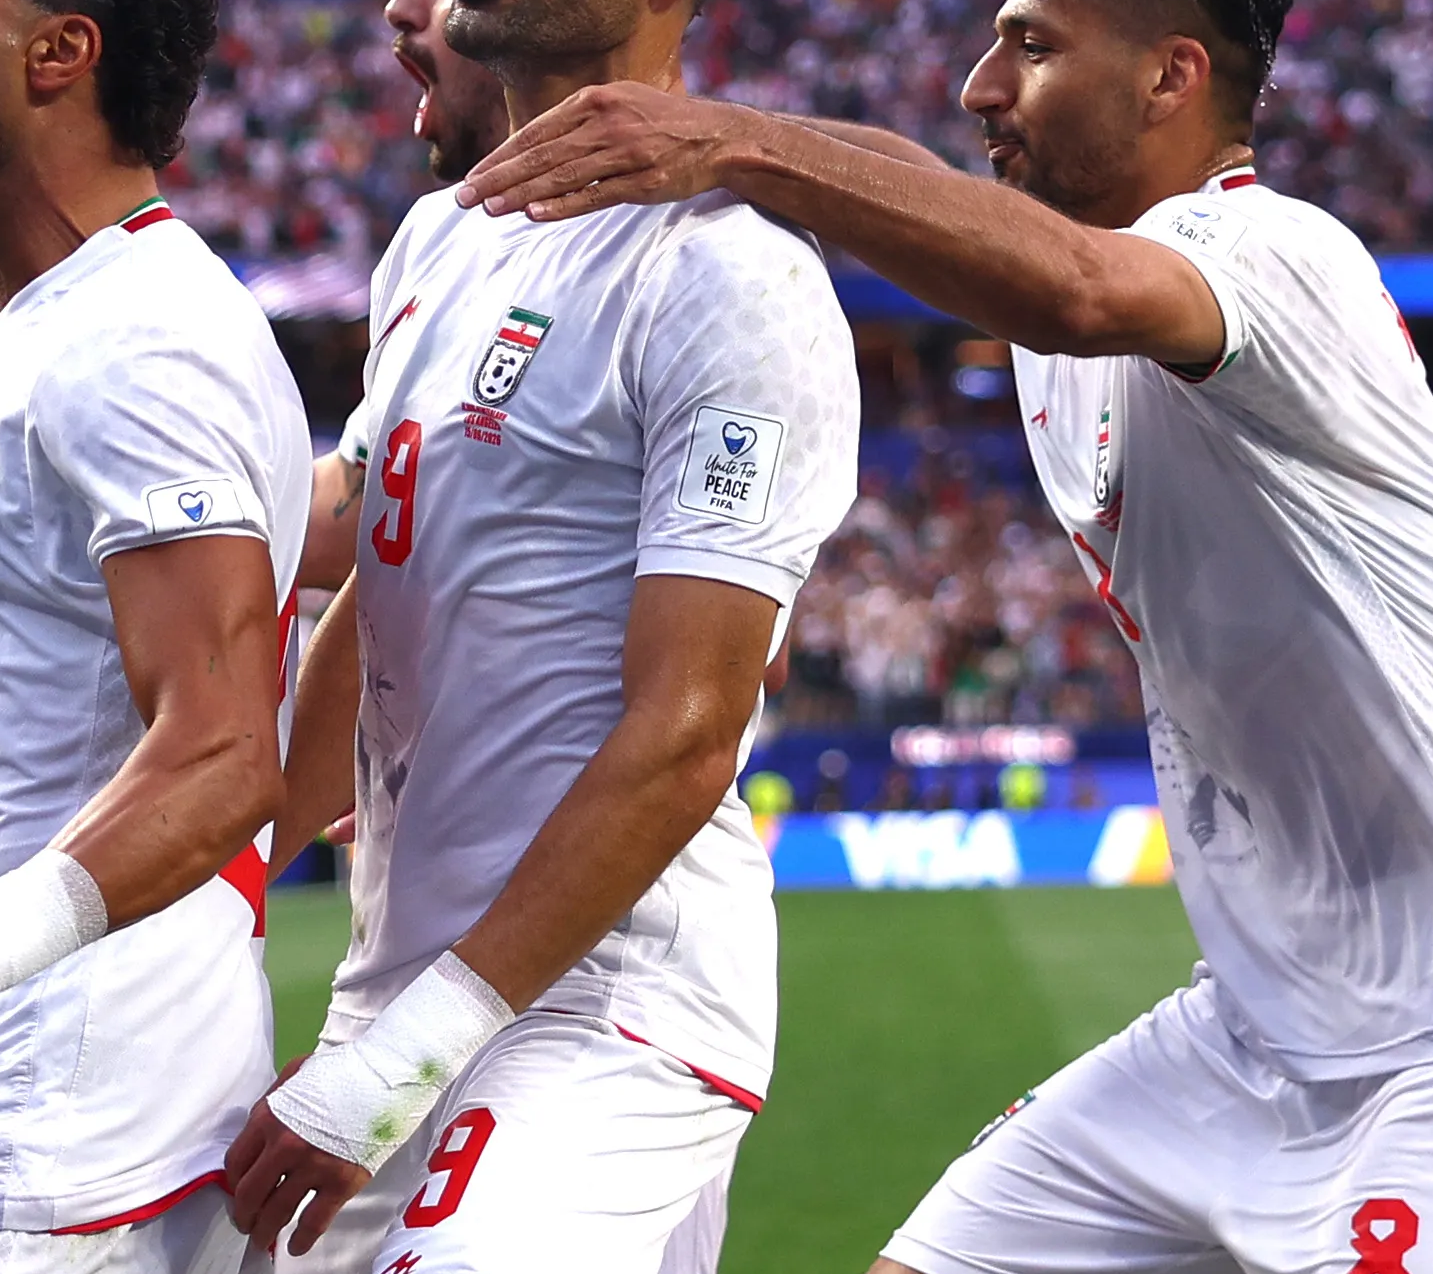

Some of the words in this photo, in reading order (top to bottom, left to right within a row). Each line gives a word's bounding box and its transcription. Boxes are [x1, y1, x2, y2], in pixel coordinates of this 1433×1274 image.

[372, 418, 422, 567] 9
[704, 453, 739, 476] Unite
[739, 461, 759, 479] For
[704, 474, 751, 501] PEACE
[709, 497, 734, 511] FIFA
[834, 808, 1025, 889] VISA
[403, 1107, 497, 1229] 9
